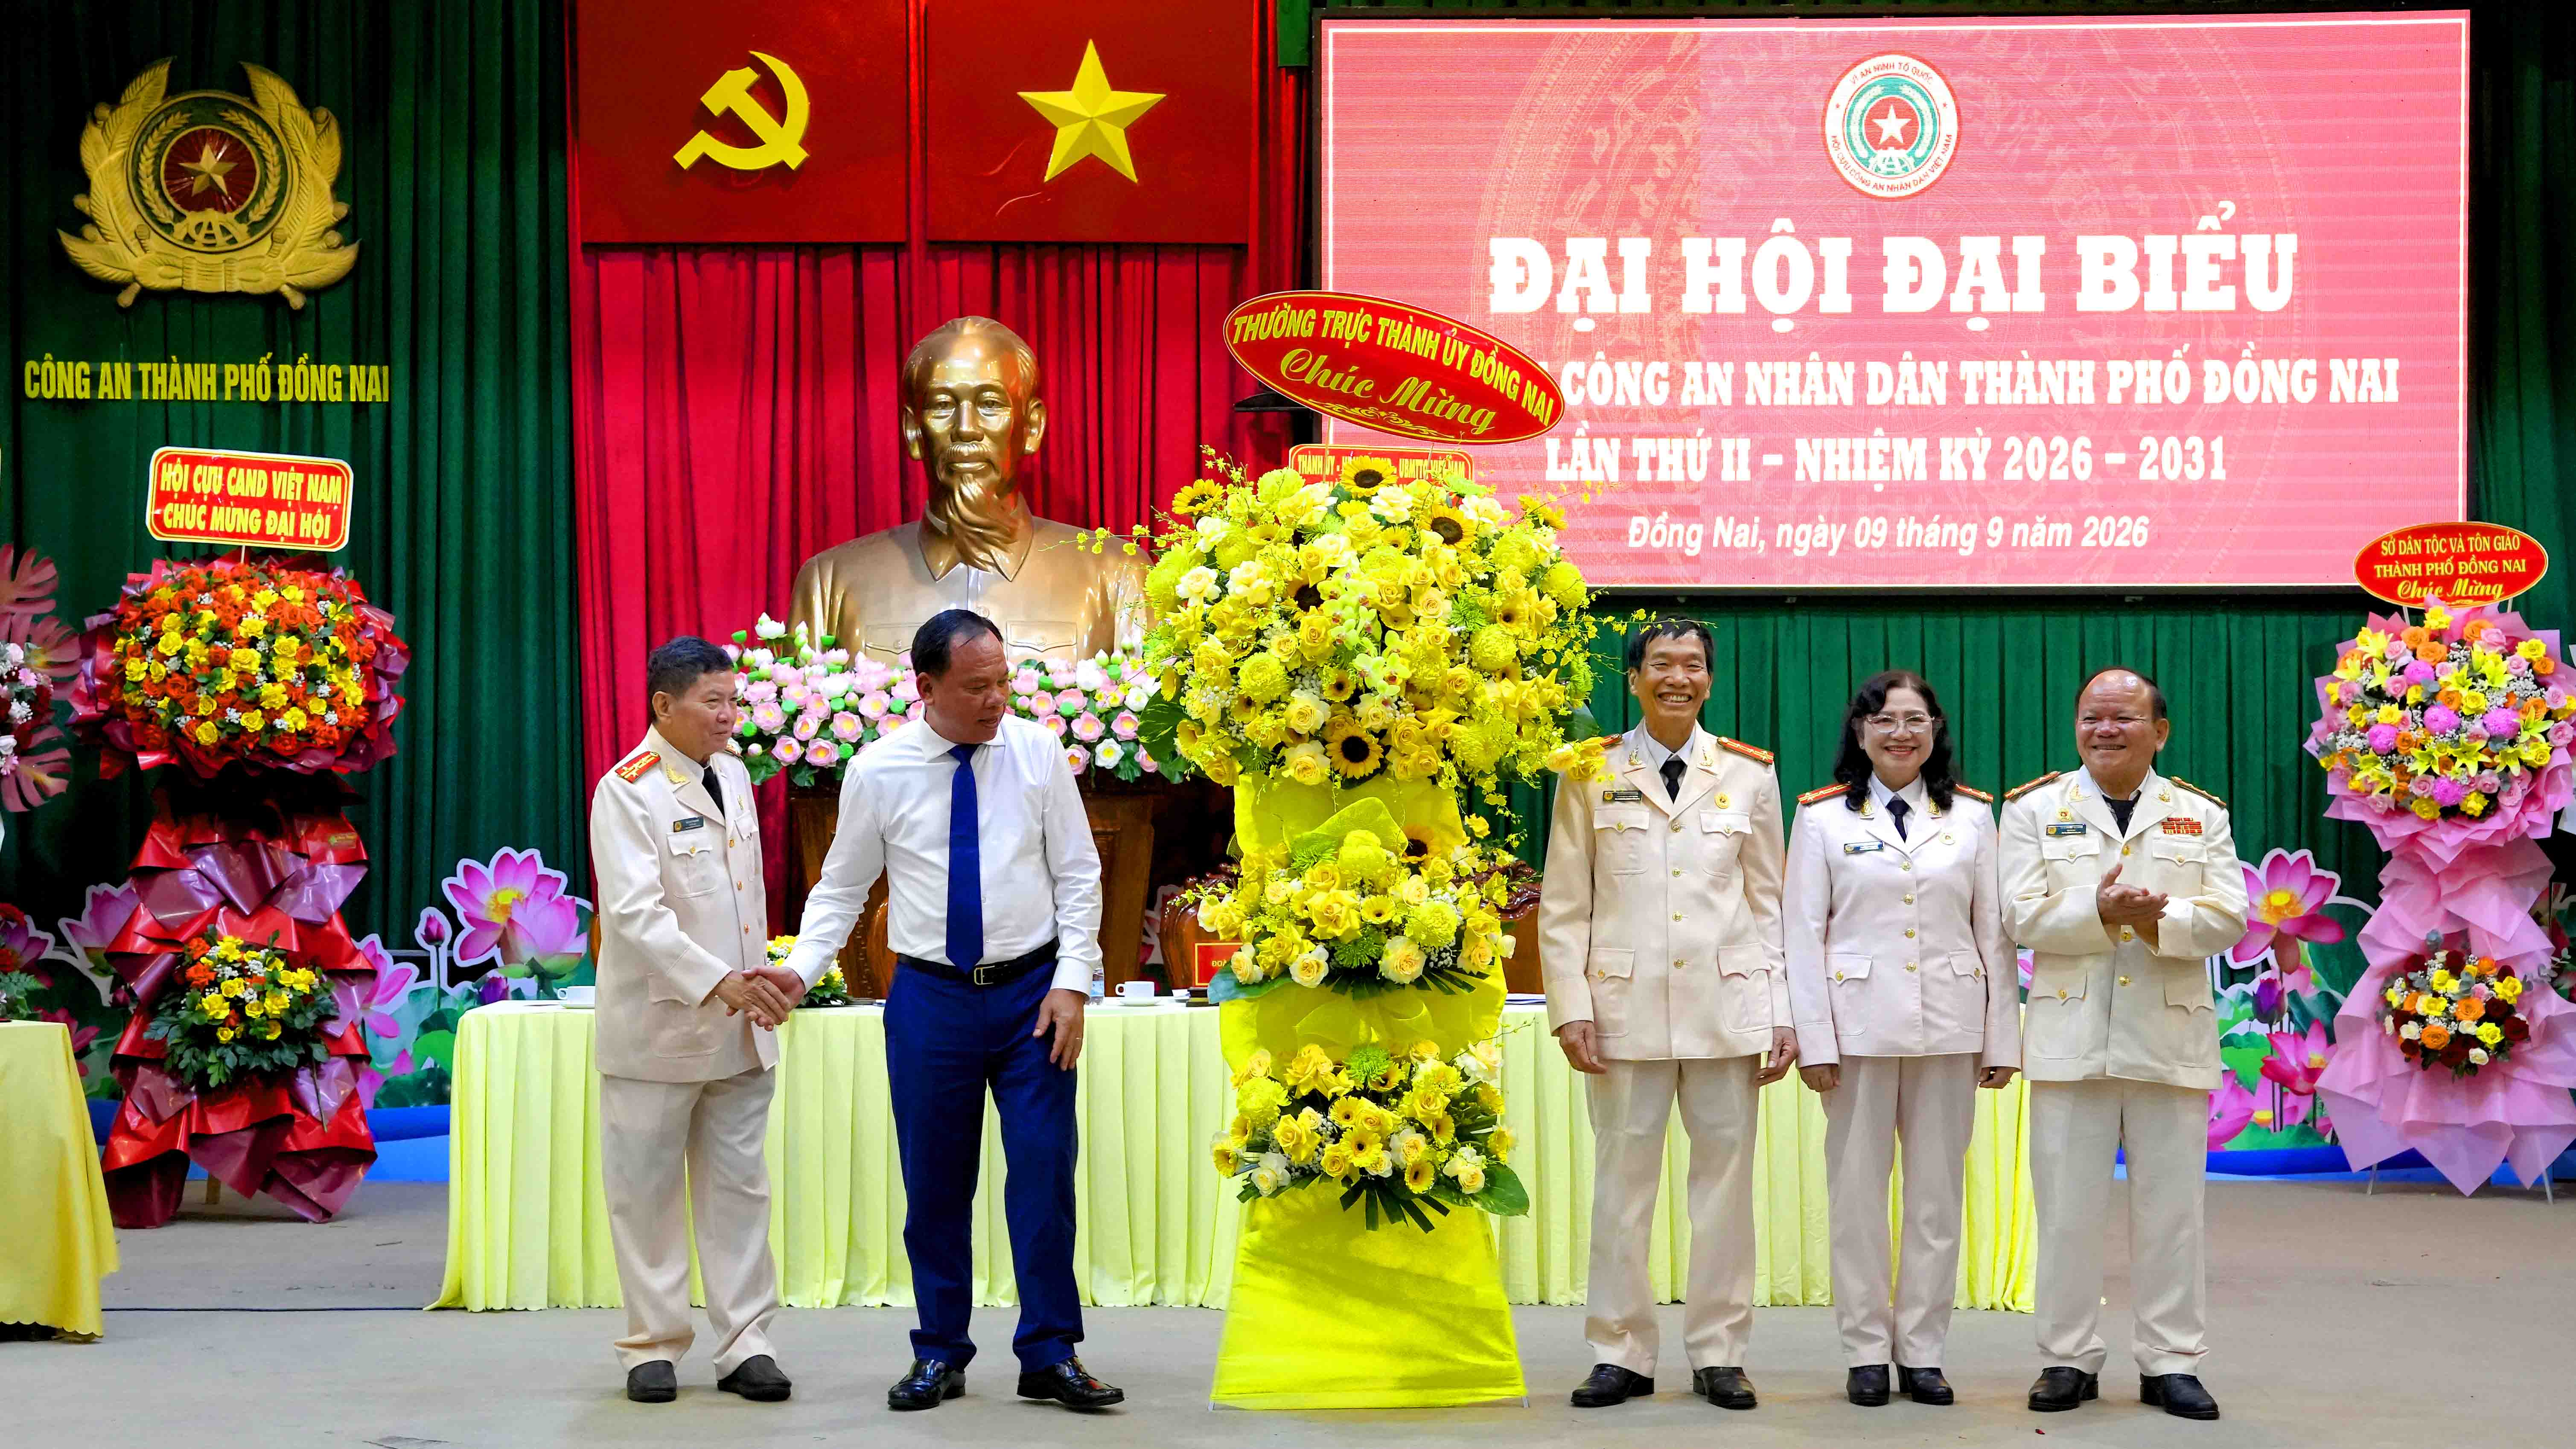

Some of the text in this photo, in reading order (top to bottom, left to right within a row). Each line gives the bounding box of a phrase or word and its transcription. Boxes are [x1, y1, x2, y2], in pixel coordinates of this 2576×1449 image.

[1489, 201, 2298, 333] ĐẠI HỘI ĐẠI BIỂU
[25, 352, 389, 402] CÔNG AN THÀNH PHỐ ĐỒNG NAI
[1233, 302, 1554, 427] THƯỜNG TRỰC THÀNH ỦY ĐỒNG NAI
[1561, 341, 2399, 406] CÔNG AN NHÂN DÂN THÀNH PHỐ ĐỒNG NAI
[1280, 348, 1496, 435] Chúc Mừng
[1545, 421, 1621, 482] LẦN
[1632, 428, 1712, 482] THỨ
[1721, 438, 1751, 481] II
[1795, 428, 1927, 492] NHIỆM
[1939, 428, 1992, 481] KỲ
[2003, 436, 2092, 481] 2026
[2139, 436, 2226, 480] 2031
[160, 457, 342, 507] HỘI CỰU CAND VIỆT NAM
[163, 498, 331, 545] CHÚC MỪNG ĐẠI HỘI
[1628, 512, 2149, 556] Đồng Nai, ngày 09 tháng 9 năm 2026
[2381, 531, 2521, 557] SỞ DÂN TỘC VÀ TÔN GIÁO
[2374, 554, 2526, 578] THÀNH PHỐ ĐỒNG NAI
[2397, 578, 2504, 599] Chúc Mừng
